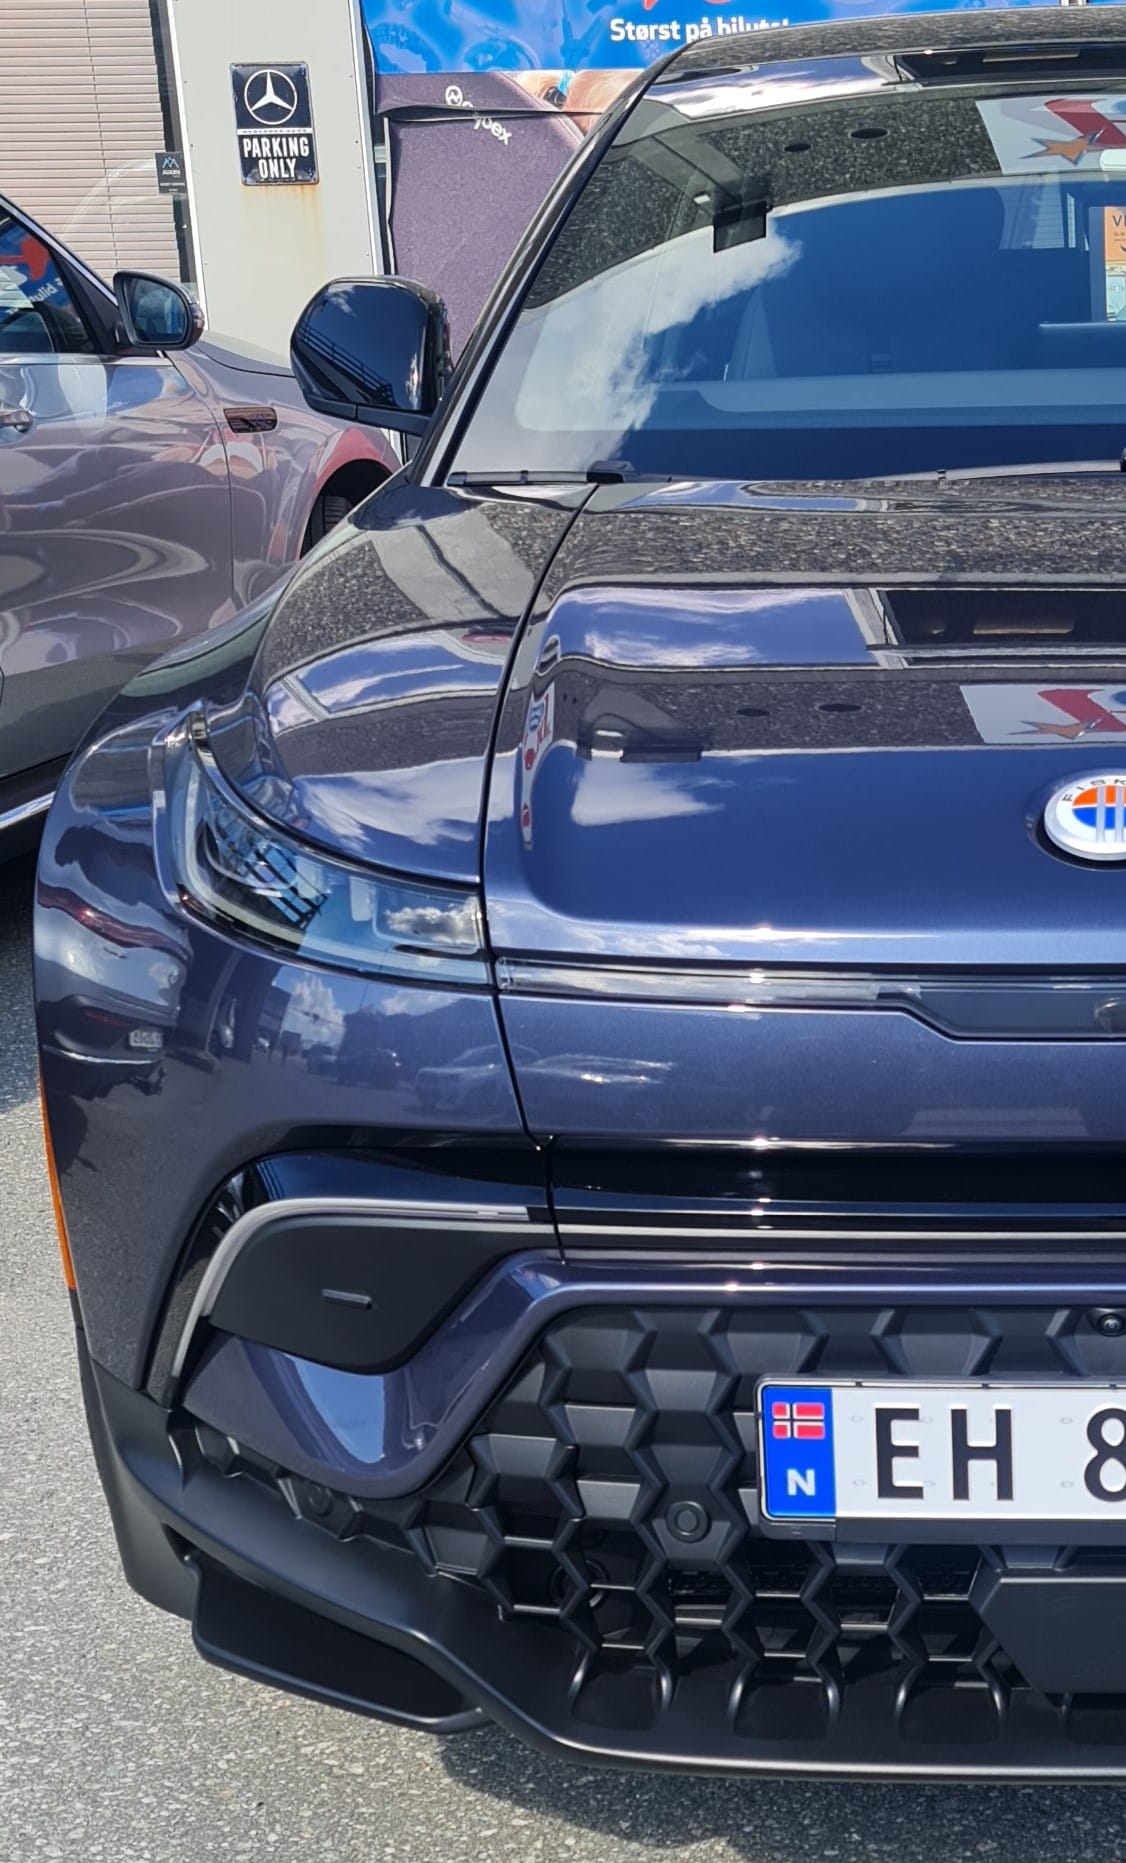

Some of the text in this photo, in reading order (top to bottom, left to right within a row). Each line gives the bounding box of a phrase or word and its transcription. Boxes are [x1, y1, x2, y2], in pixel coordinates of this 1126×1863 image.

[609, 18, 681, 42] Størst
[686, 17, 713, 44] på
[242, 137, 310, 158] PARKING
[258, 158, 297, 179] ONLY
[875, 1407, 1014, 1501] EH
[787, 1468, 816, 1496] N
